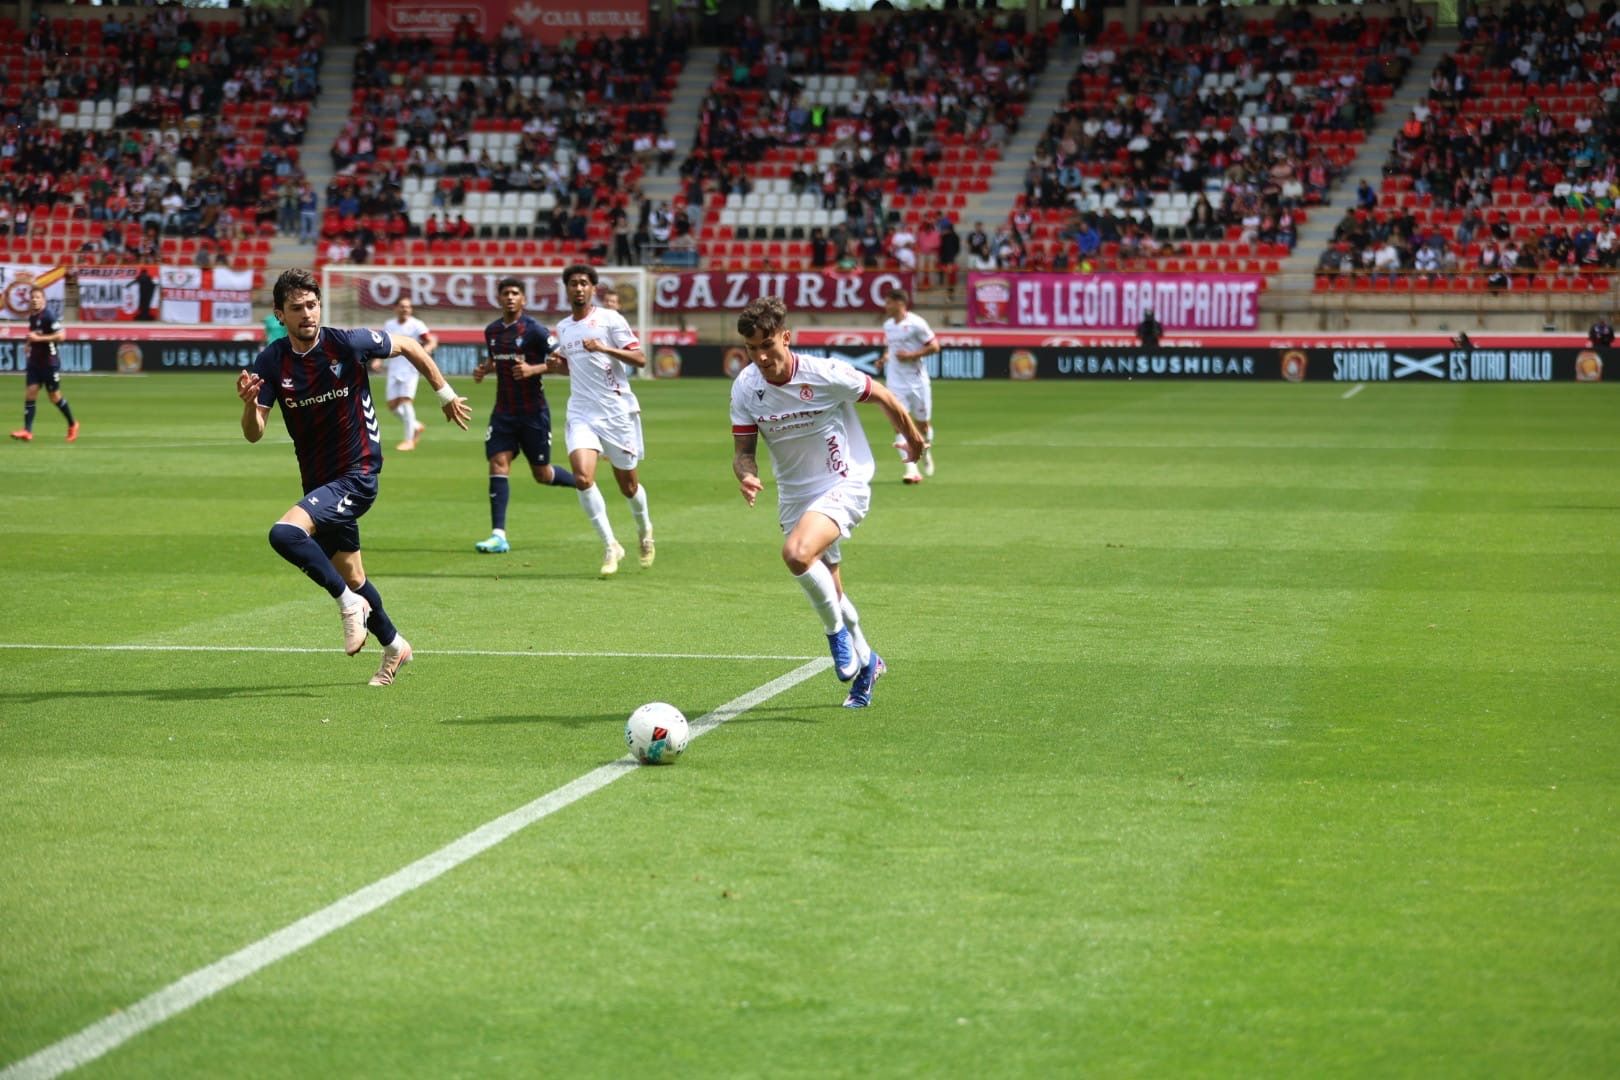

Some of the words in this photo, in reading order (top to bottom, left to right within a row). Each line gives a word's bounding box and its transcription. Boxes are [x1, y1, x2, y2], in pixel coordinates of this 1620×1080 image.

[655, 273, 902, 308] CAZURRO
[1017, 281, 1048, 325] EL
[1054, 274, 1117, 326] LEÓN
[1122, 281, 1258, 328] RAMPANTE
[1057, 356, 1255, 374] URBANSUSHIBAR
[1333, 351, 1389, 381] SIBUYA
[1450, 351, 1468, 381] ES
[1471, 351, 1506, 381] OTRO
[1509, 351, 1552, 381] ROLLO
